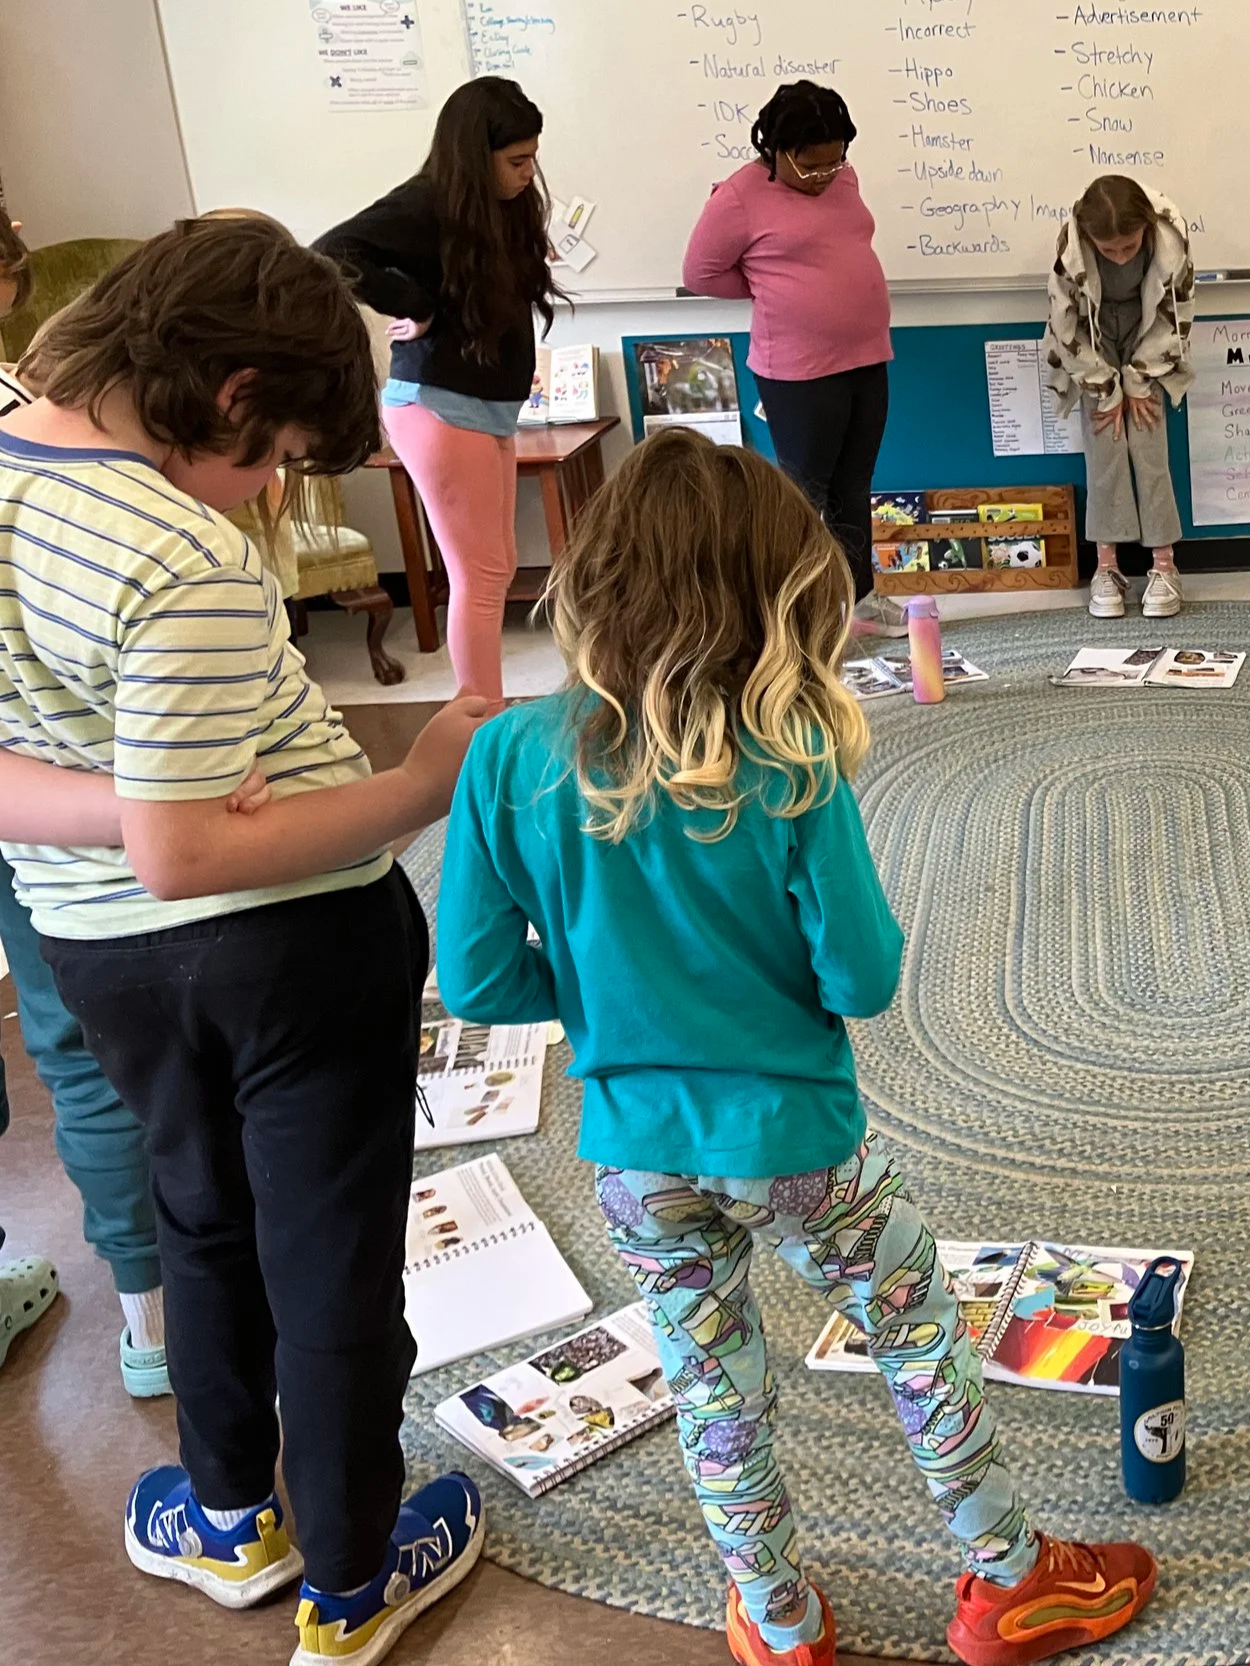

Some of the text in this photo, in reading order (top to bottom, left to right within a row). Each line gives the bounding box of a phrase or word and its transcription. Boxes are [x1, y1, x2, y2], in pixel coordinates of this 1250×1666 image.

[692, 5, 761, 46] Rugby
[1074, 3, 1203, 26] Advertisement
[899, 17, 976, 41] Incorrect
[704, 54, 842, 79] Natural disaster
[1072, 41, 1153, 75] Stretchy
[905, 58, 953, 86] Hippo
[1078, 74, 1154, 101] Chicken
[910, 91, 972, 116] Shoes
[1085, 107, 1133, 133] Snow
[911, 125, 974, 151] Hamster
[1089, 144, 1165, 168] Nonsense
[920, 197, 1022, 231] Geography
[920, 235, 1011, 257] Backwards
[1160, 1412, 1174, 1427] 50
